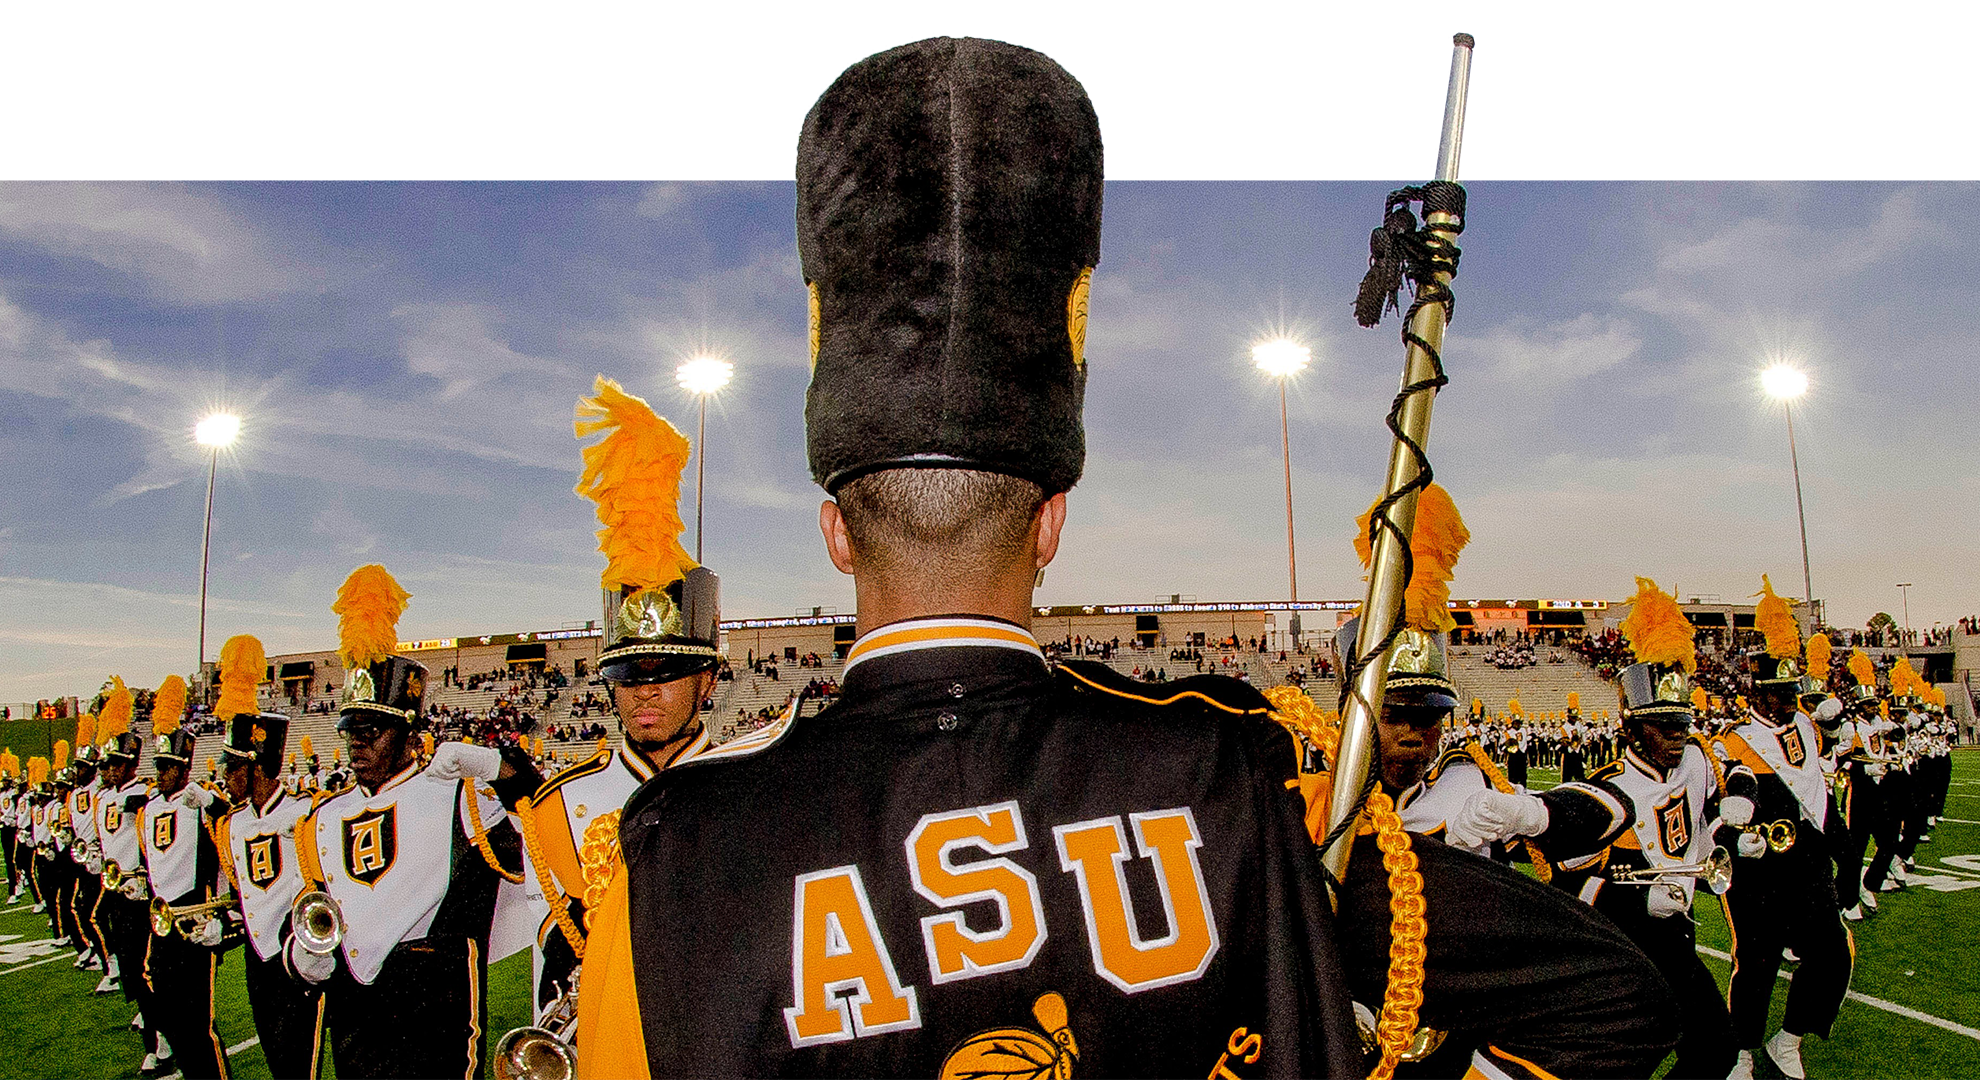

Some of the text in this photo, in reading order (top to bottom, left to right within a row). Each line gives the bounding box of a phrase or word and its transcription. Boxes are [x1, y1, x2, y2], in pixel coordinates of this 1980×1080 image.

[746, 620, 765, 628] When
[800, 618, 817, 626] reply
[818, 616, 834, 624] with
[42, 706, 57, 719] 25
[1783, 729, 1804, 765] A
[156, 815, 172, 848] A
[351, 814, 386, 876] A
[1664, 799, 1688, 853] A
[250, 838, 275, 883] A
[783, 800, 1221, 1049] ASU
